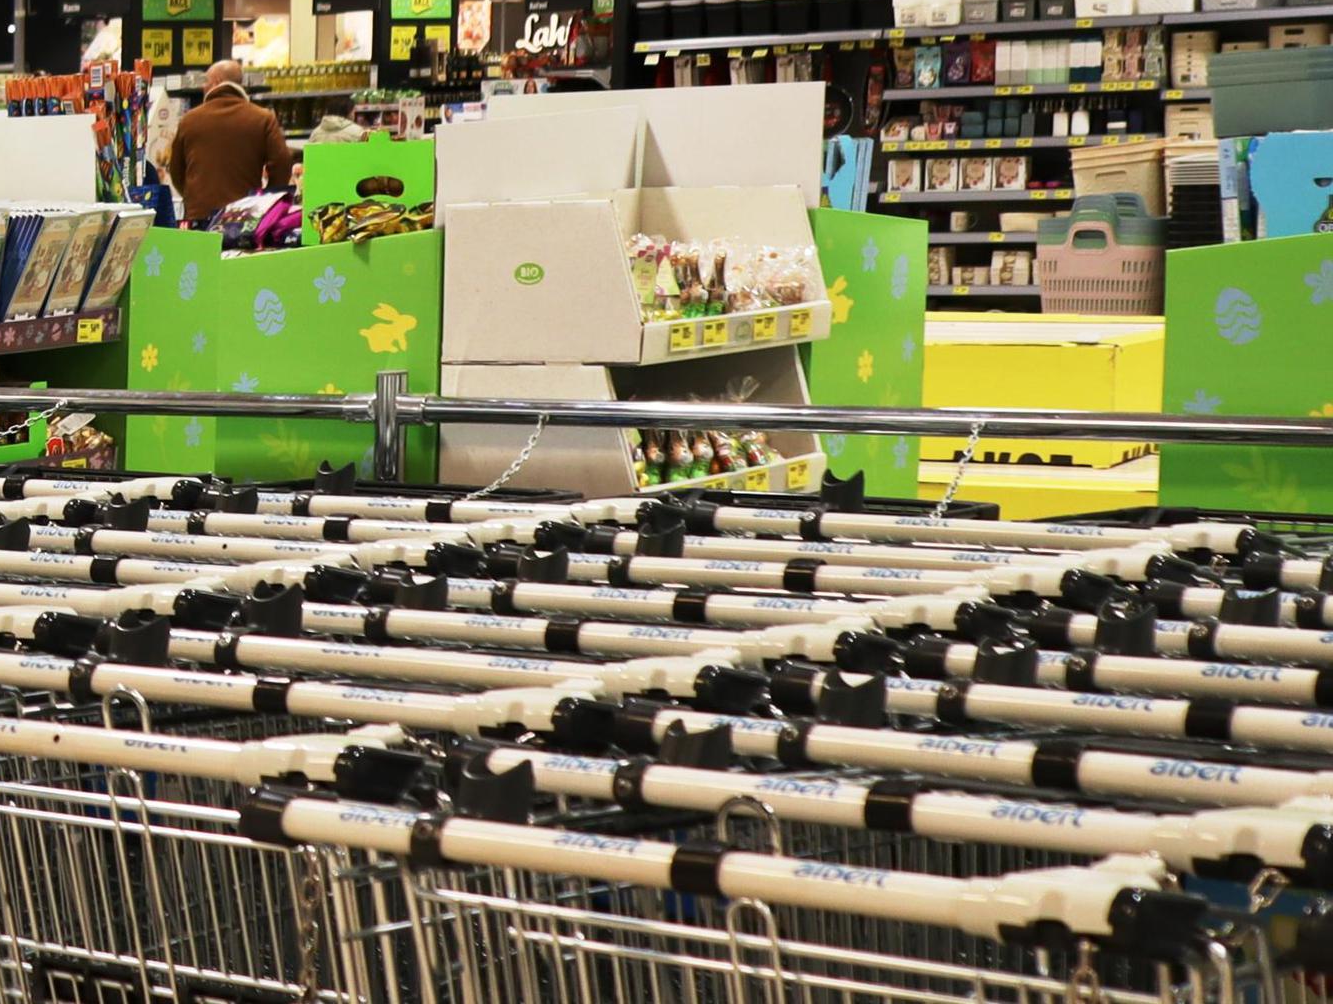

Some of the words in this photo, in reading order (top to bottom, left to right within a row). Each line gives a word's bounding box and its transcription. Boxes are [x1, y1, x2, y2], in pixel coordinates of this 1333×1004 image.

[520, 267, 540, 279] BIO
[1201, 662, 1281, 682] albert
[1072, 692, 1153, 712] albert
[918, 736, 1000, 758] albert
[1150, 758, 1241, 784] albert
[755, 778, 840, 797] albert
[991, 799, 1084, 828] albert
[552, 830, 640, 855] albert
[794, 861, 887, 889] albert
